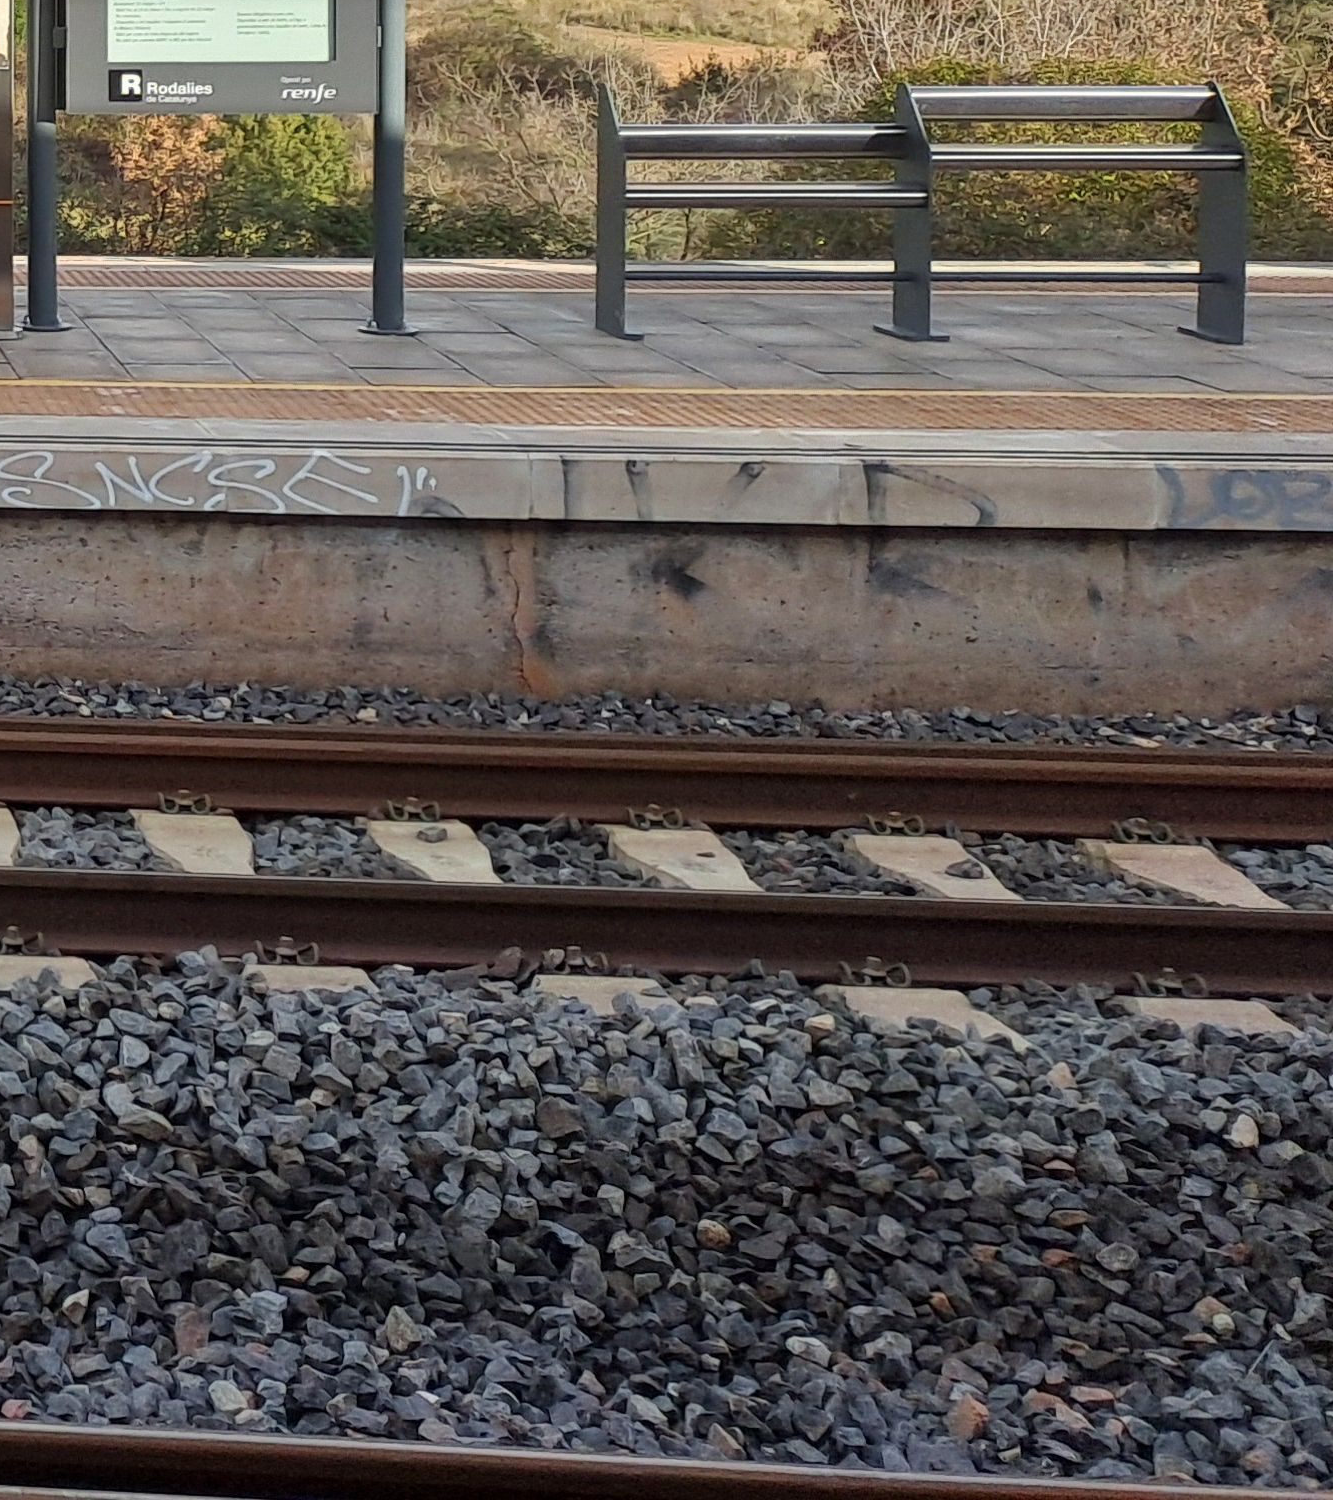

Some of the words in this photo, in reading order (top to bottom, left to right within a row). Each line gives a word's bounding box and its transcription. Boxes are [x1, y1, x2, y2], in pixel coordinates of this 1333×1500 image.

[120, 73, 142, 96] R
[146, 81, 213, 96] Rodalies
[281, 82, 338, 104] renfe
